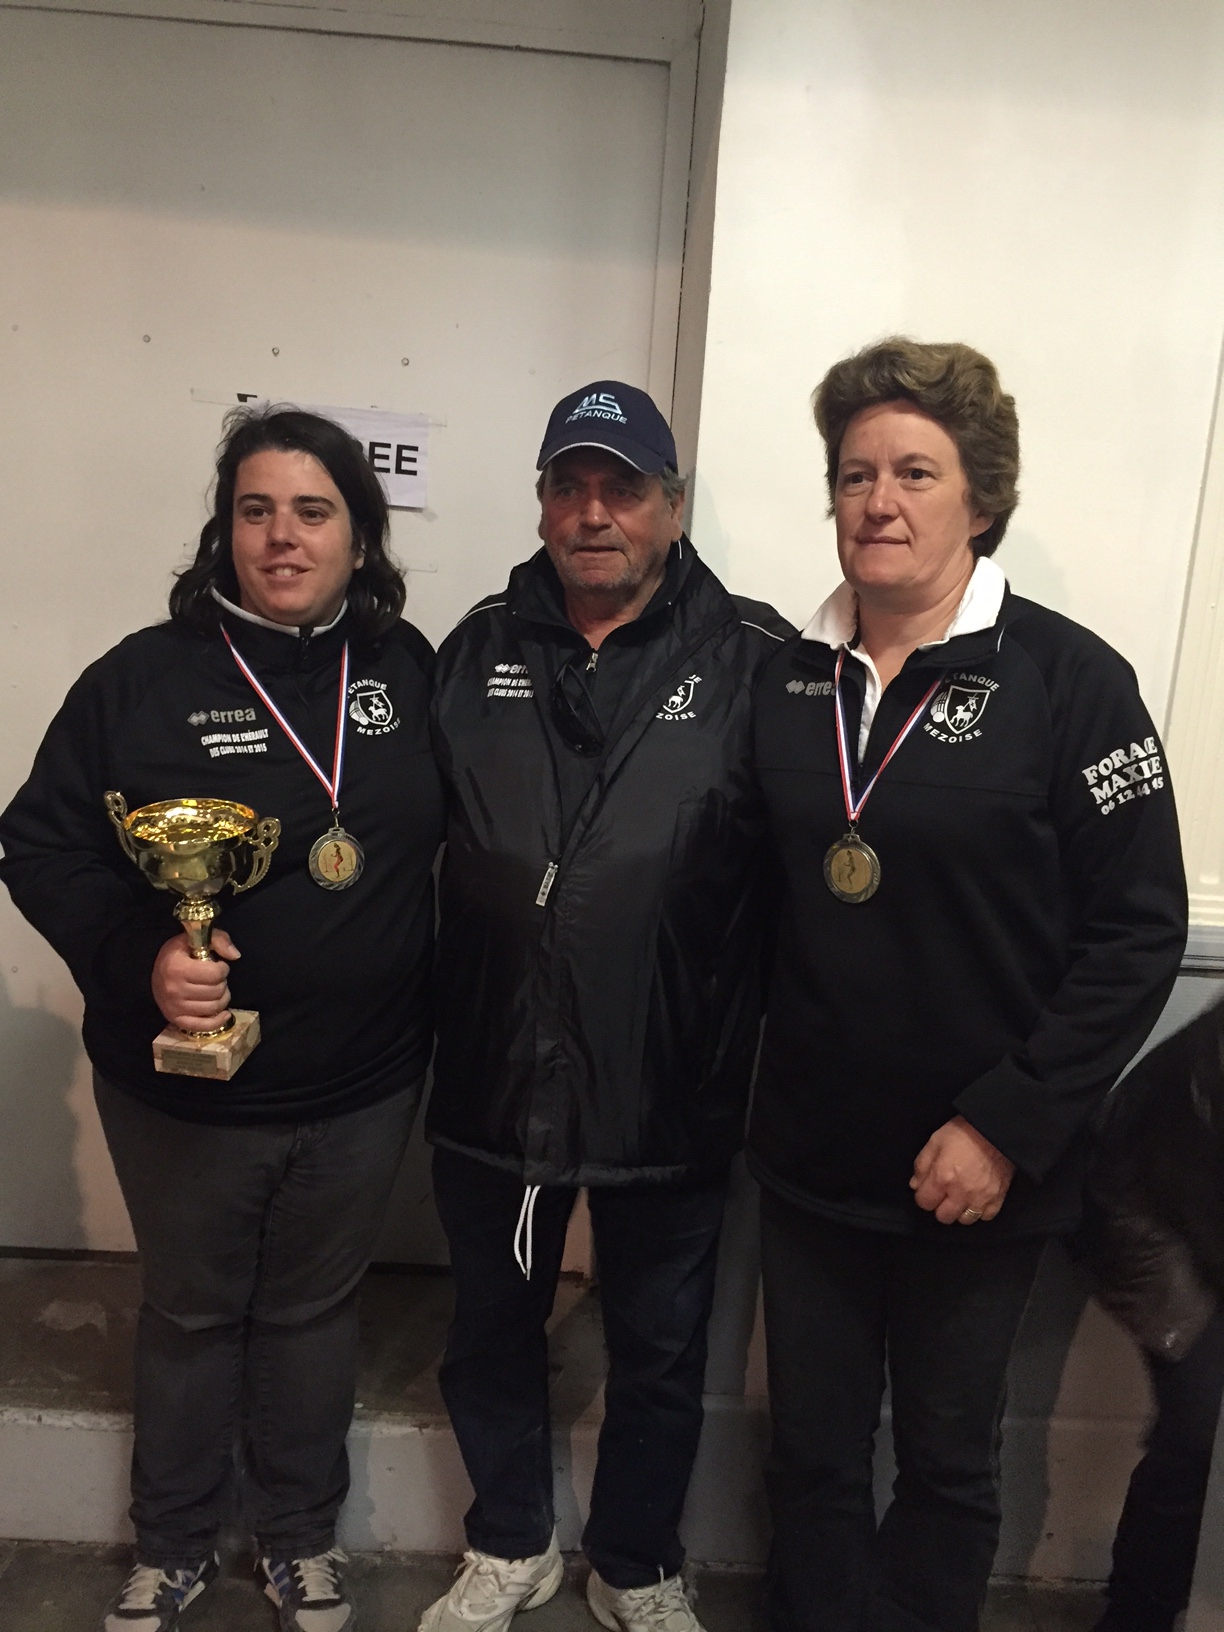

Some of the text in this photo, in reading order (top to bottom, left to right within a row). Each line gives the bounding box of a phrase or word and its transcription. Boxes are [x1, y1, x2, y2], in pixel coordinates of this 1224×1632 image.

[565, 409, 628, 425] PETANQUE
[368, 441, 419, 476] EE
[347, 678, 388, 696] ETANQUE
[945, 672, 1000, 692] TANQUE
[655, 711, 697, 721] ZOISE
[201, 733, 232, 746] CHAMPION
[232, 733, 241, 743] DE
[923, 722, 983, 744] MEZOISE
[254, 742, 268, 753] 2015
[1116, 789, 1135, 804] 12
